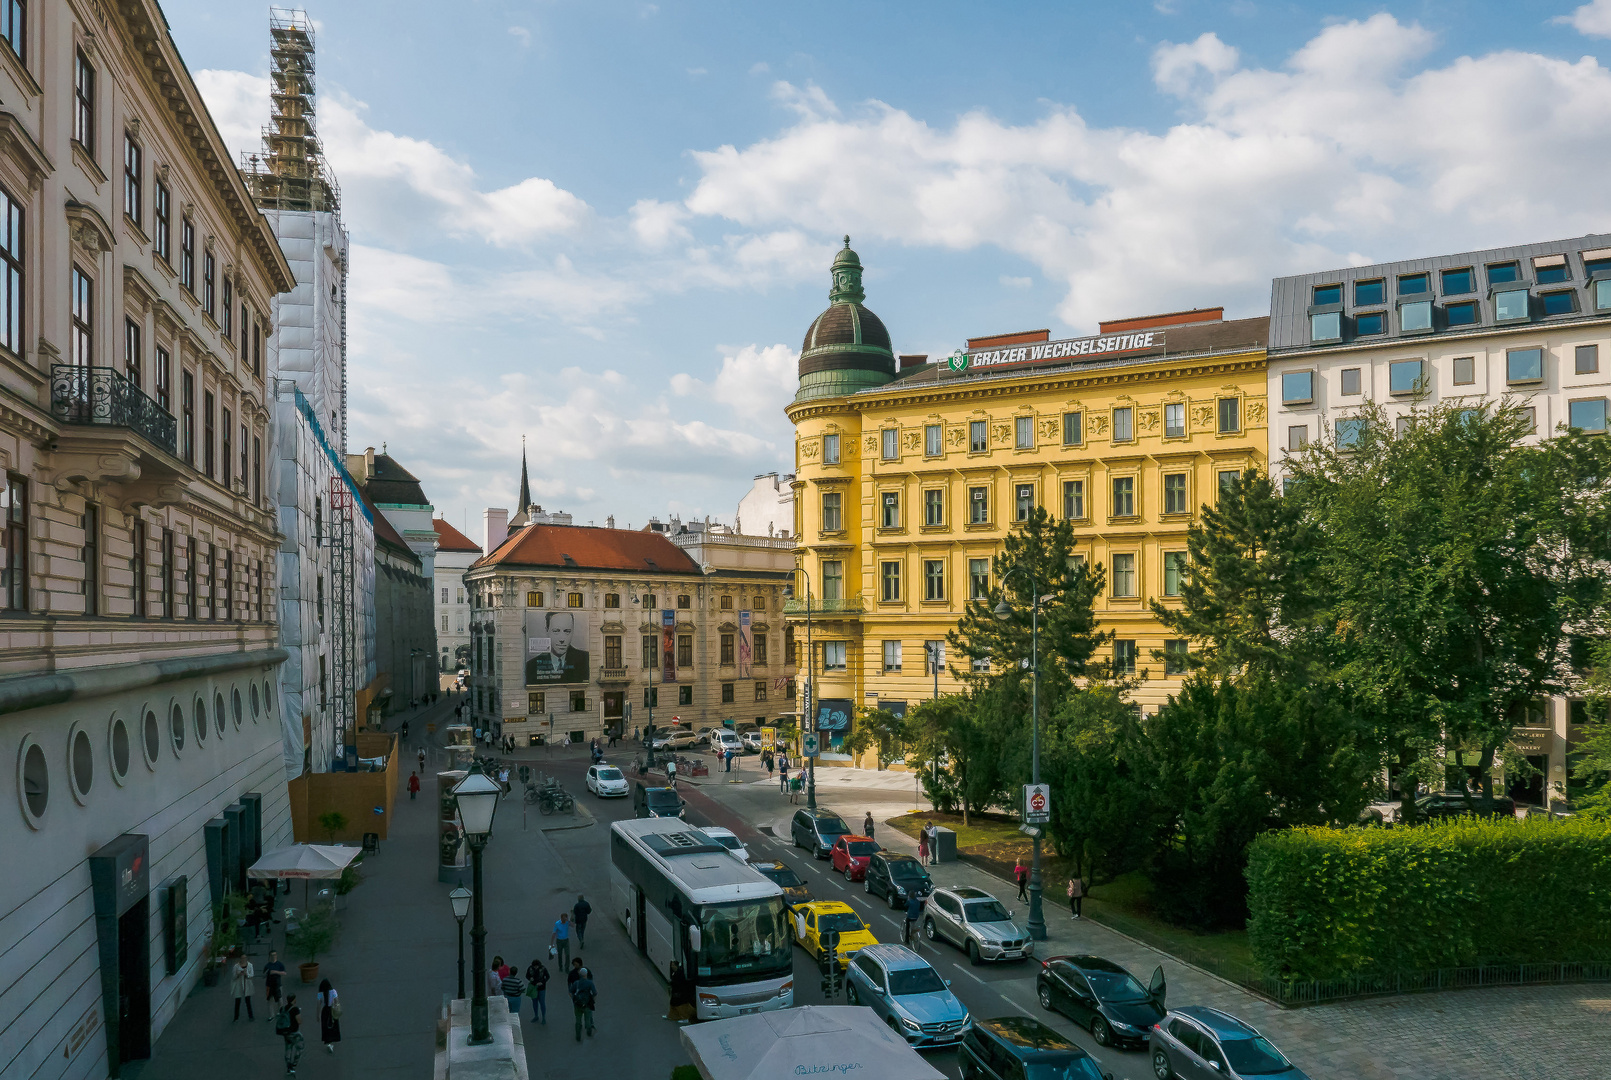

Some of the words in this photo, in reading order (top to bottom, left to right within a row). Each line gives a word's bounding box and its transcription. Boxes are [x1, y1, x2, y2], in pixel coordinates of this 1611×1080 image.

[973, 347, 1027, 367] GRAZER
[1031, 332, 1154, 360] WECHSELSEITIGE
[794, 1062, 864, 1076] Bitzinger
